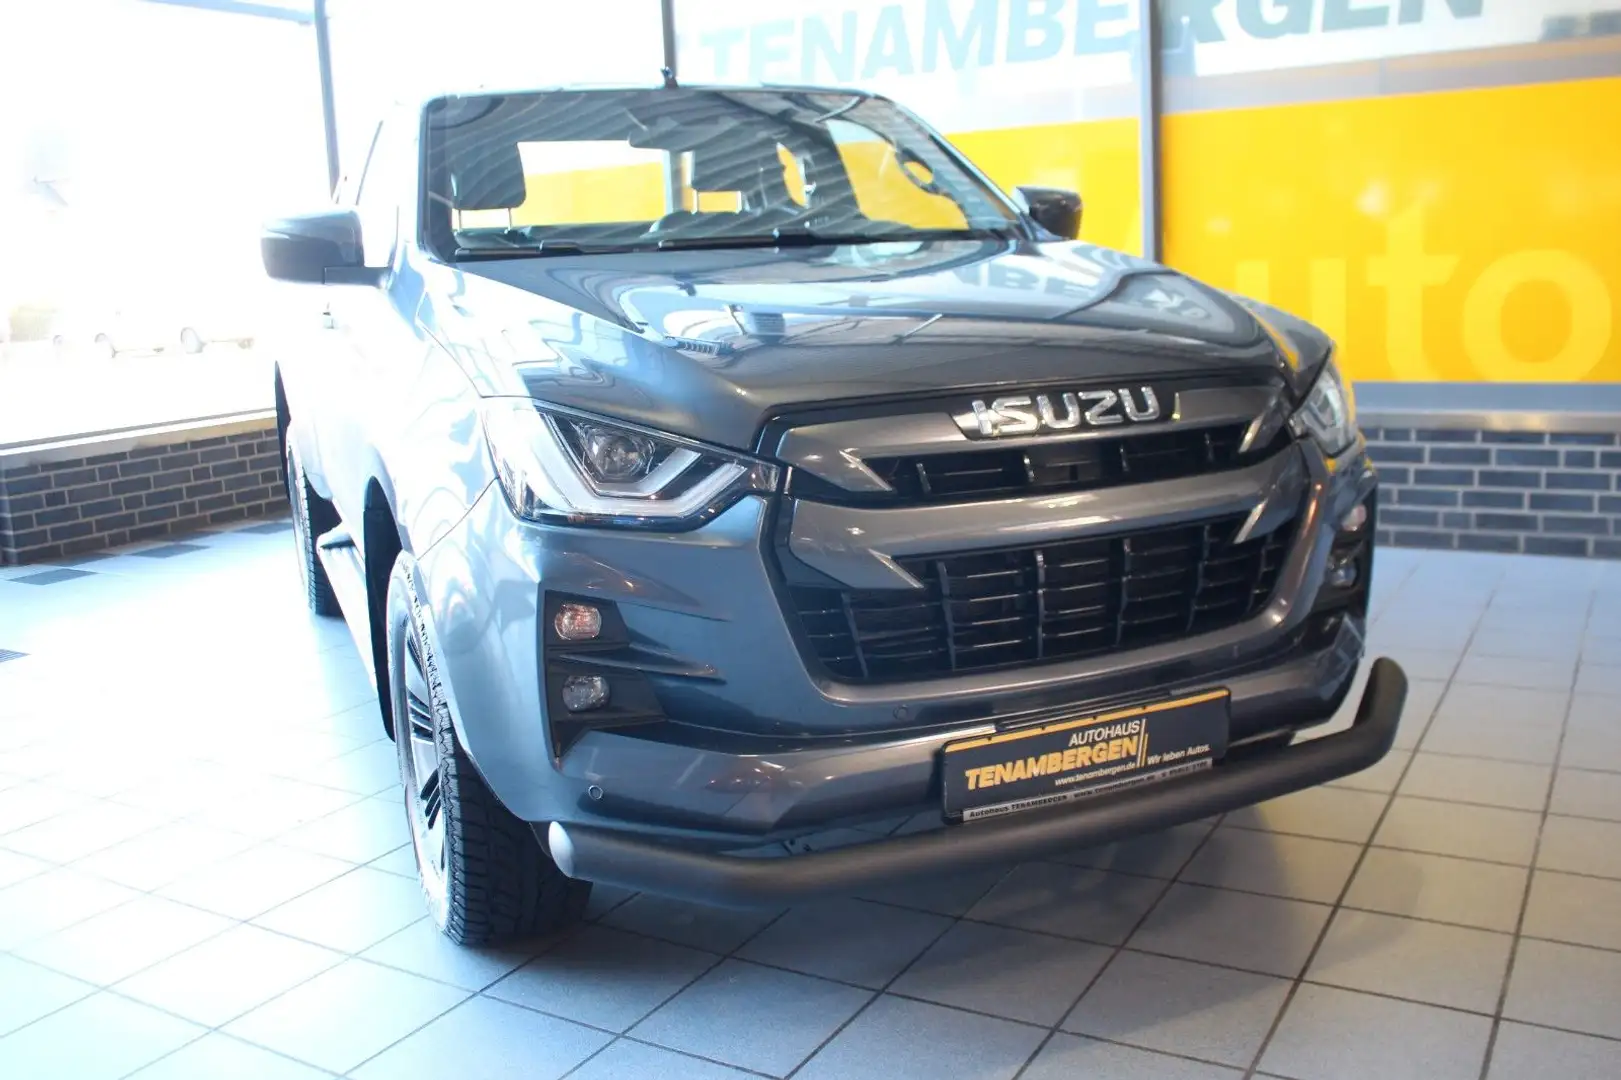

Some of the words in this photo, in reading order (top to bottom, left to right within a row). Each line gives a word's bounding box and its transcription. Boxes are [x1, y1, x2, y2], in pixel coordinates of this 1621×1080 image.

[971, 386, 1161, 436] ISUZU
[1068, 720, 1140, 747] AUTOHAUS
[965, 735, 1139, 791] TENAMBERGEN
[1147, 754, 1161, 765] Wir
[970, 806, 1010, 818] Autohaus
